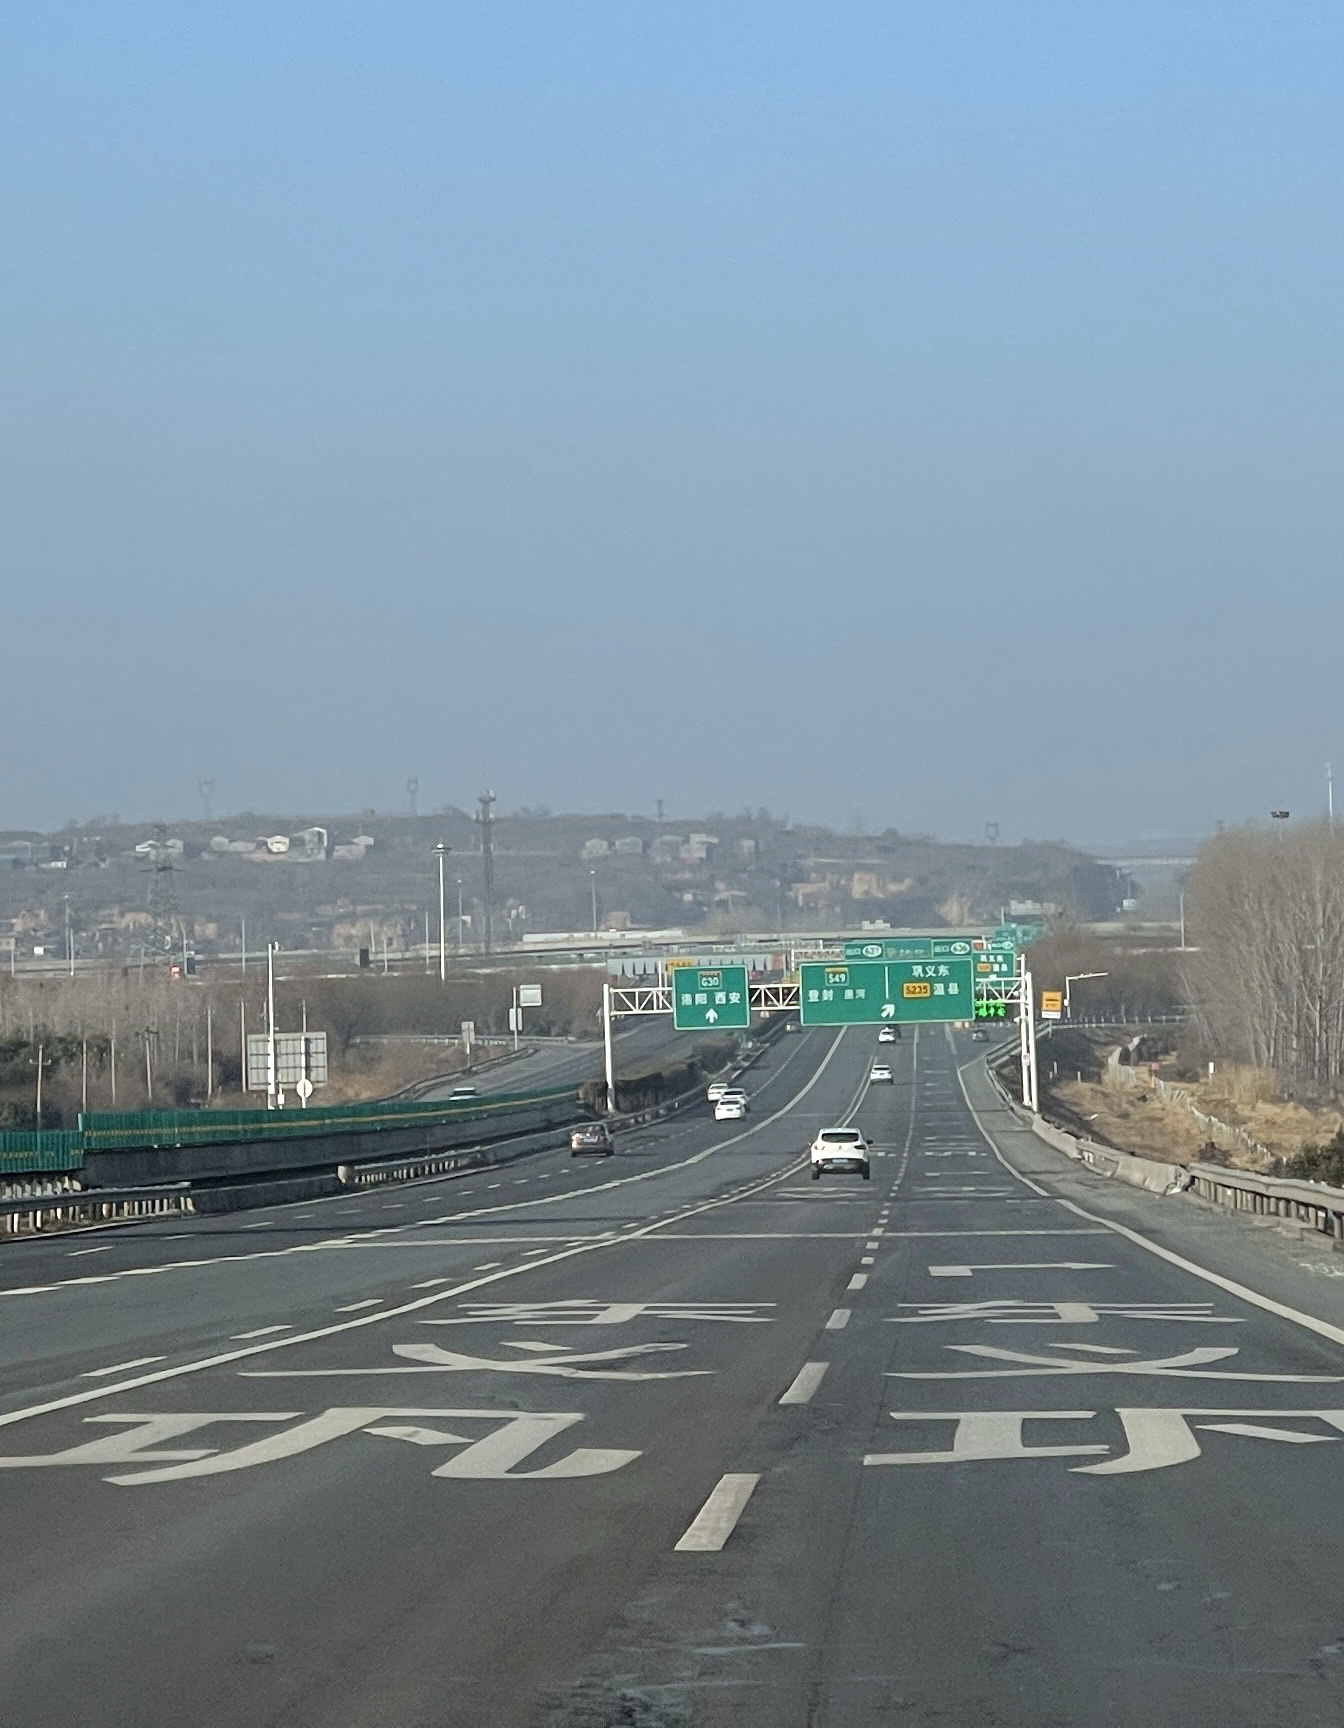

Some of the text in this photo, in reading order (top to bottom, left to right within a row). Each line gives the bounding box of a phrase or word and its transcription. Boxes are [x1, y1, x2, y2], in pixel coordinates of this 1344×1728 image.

[911, 964, 950, 978] 巩义东
[828, 973, 846, 983] S49
[905, 985, 928, 994] S235
